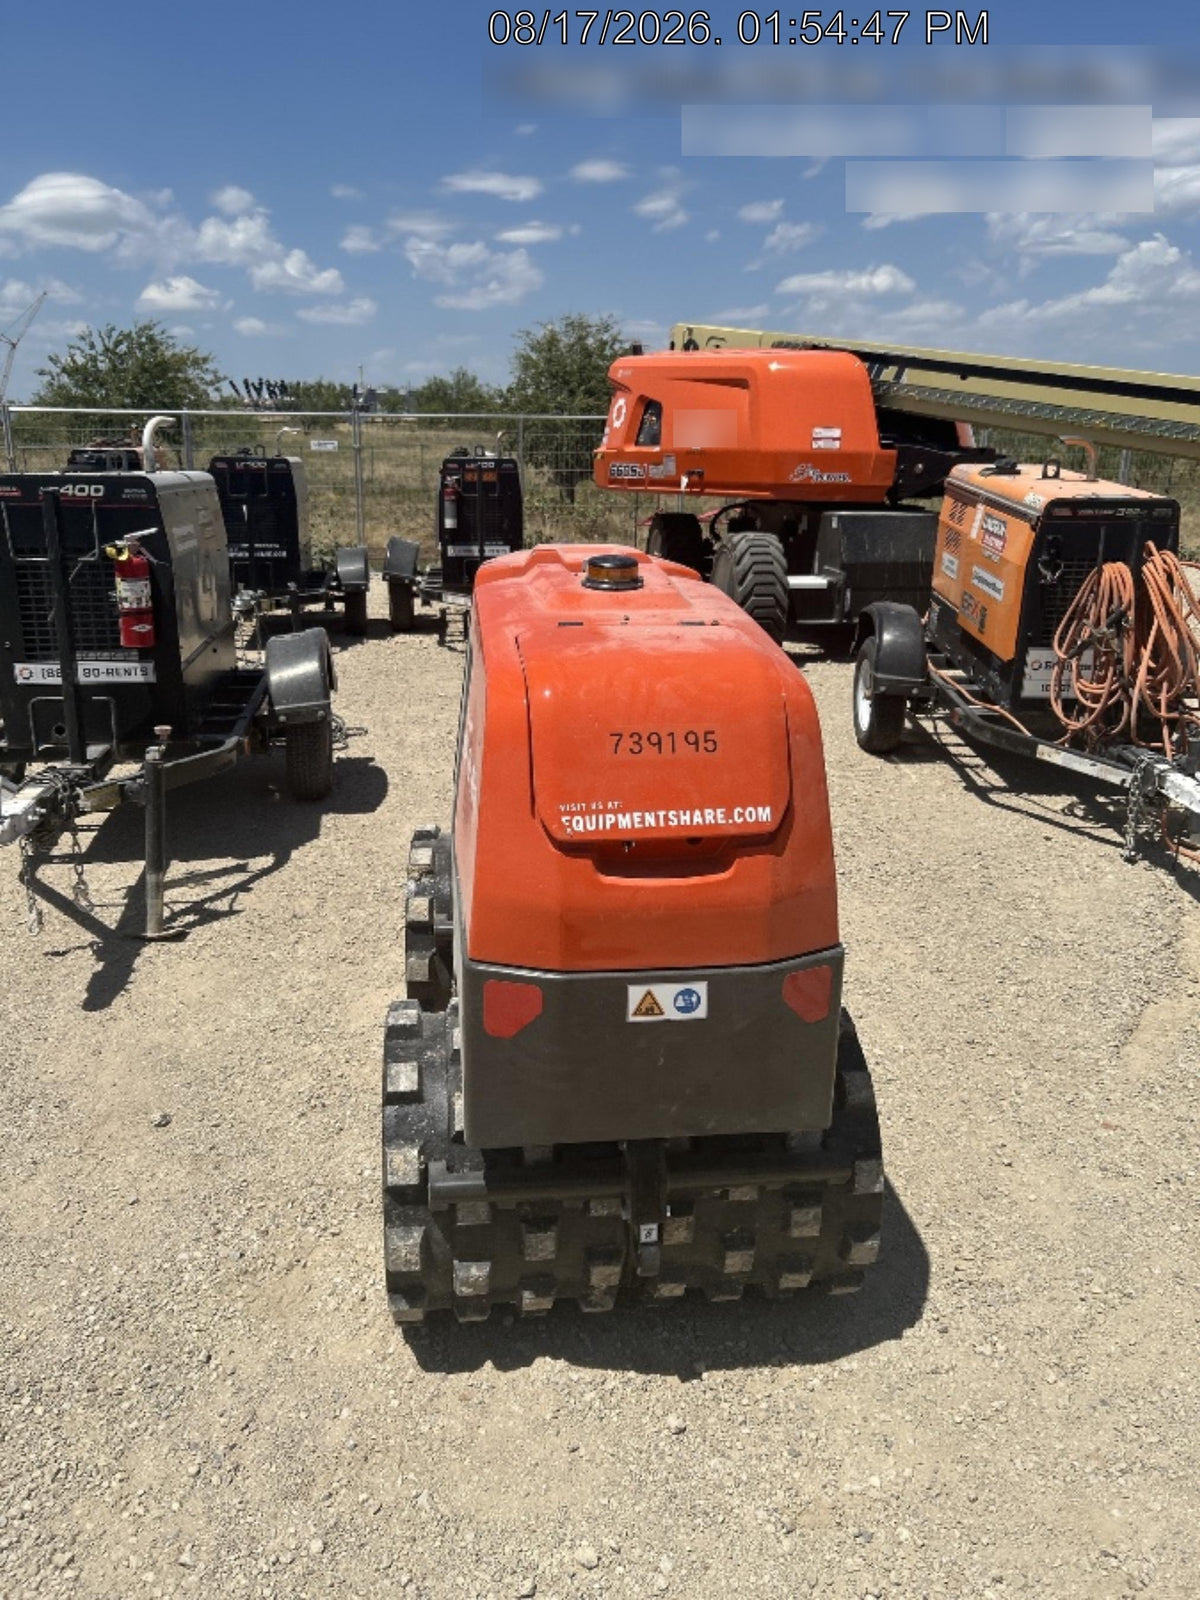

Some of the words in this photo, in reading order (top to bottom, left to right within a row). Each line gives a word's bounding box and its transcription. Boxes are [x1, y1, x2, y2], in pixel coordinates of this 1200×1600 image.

[59, 484, 104, 497] 400
[609, 730, 718, 755] 739195
[559, 803, 587, 812] VISIT
[561, 806, 772, 833] EQUIPMENTSHARE.COM
